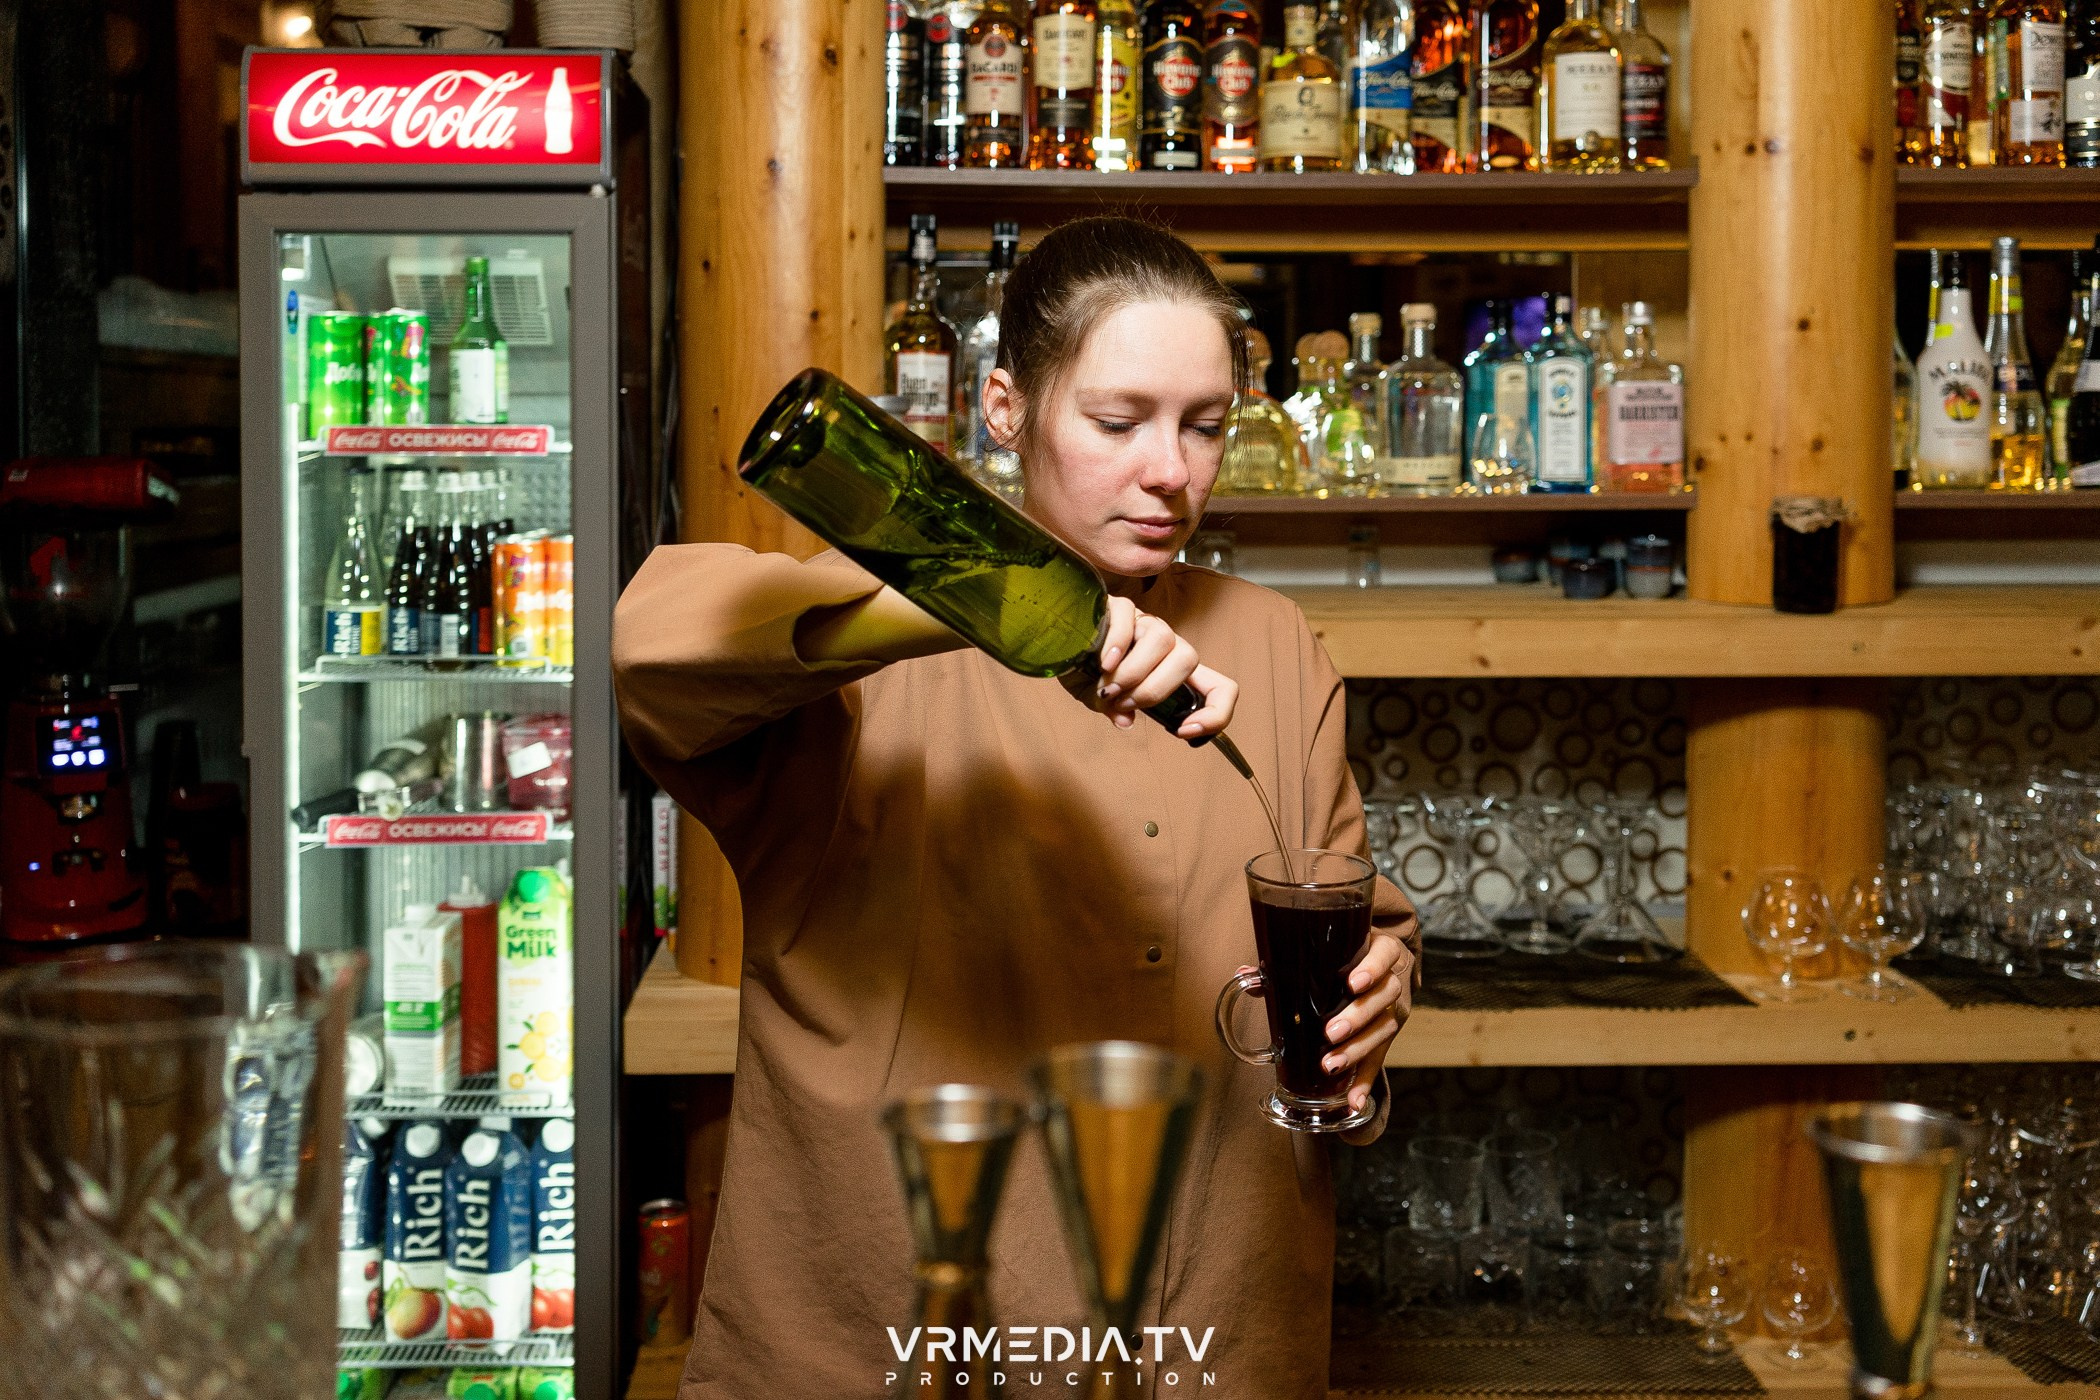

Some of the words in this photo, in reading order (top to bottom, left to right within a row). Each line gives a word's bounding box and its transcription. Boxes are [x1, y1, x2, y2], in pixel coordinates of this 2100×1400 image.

[273, 67, 535, 149] Coca-Cola
[506, 924, 557, 939] Green
[507, 941, 556, 959] Milk
[404, 1167, 443, 1259] Rich
[455, 1178, 491, 1270] Rich
[538, 1161, 575, 1253] Rich
